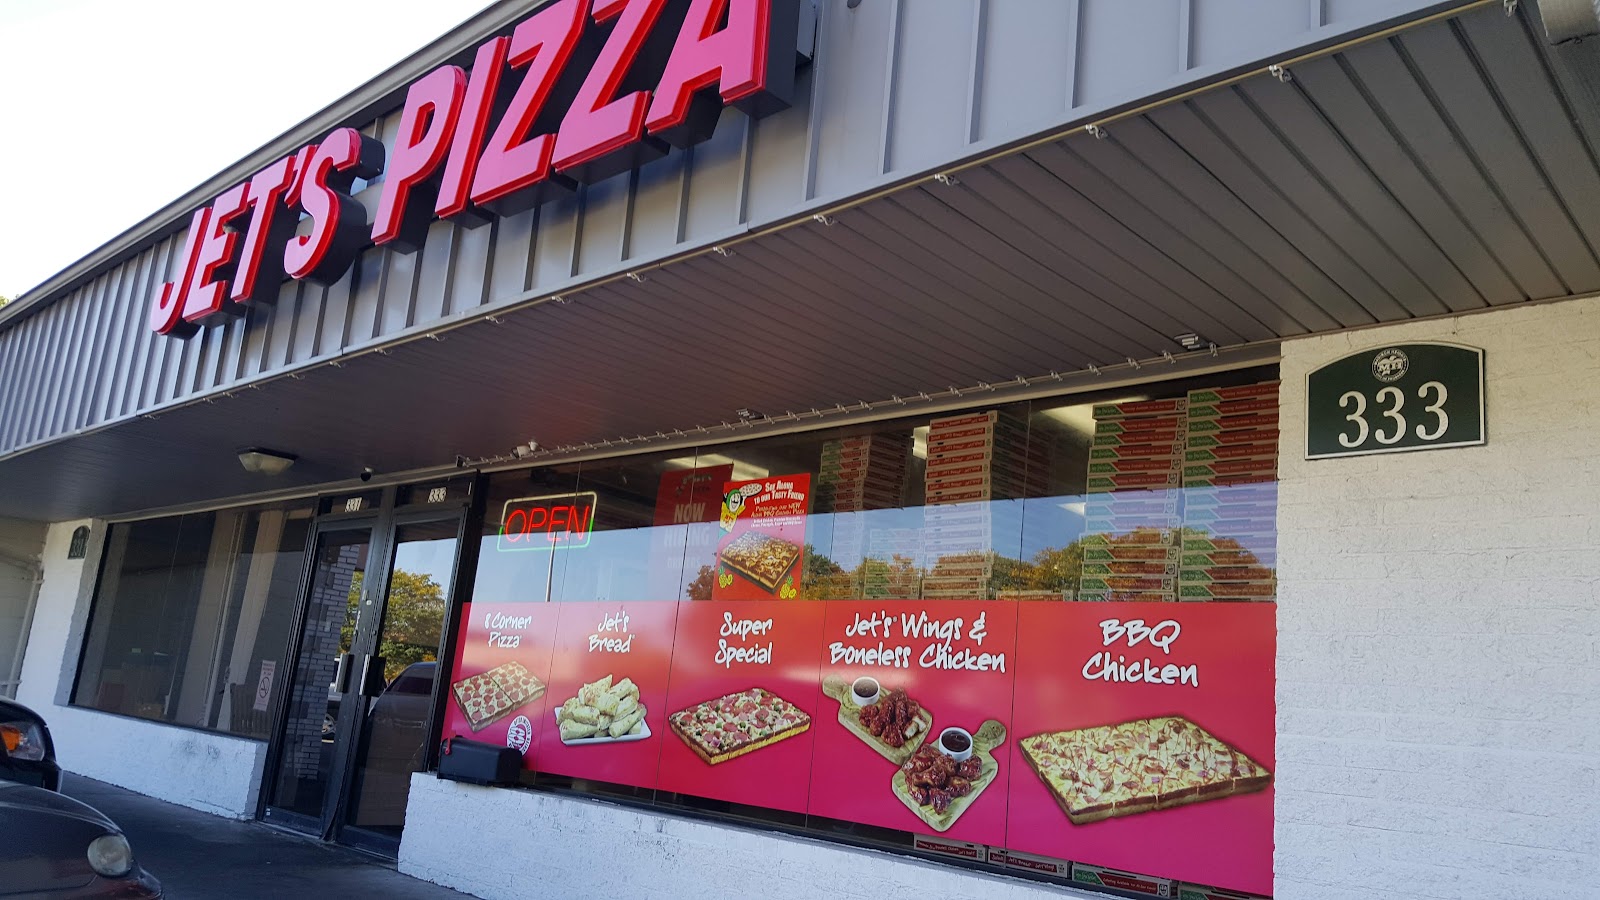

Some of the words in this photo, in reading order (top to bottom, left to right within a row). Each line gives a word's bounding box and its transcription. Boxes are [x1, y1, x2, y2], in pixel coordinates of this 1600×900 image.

[151, 127, 363, 336] JET'S
[371, 0, 773, 246] PIZZA
[1338, 381, 1449, 448] 333
[505, 505, 590, 543] OPEN
[674, 502, 706, 524] NOW
[664, 526, 711, 547] HIRING
[484, 613, 492, 629] 8
[491, 612, 532, 630] Corner
[597, 611, 630, 632] Jet's
[720, 611, 773, 641] Super
[845, 610, 893, 638] Jet's
[901, 610, 964, 650] Wings
[968, 611, 987, 646] &
[1100, 619, 1181, 654] BBQ
[488, 631, 520, 648] Pizza
[588, 634, 632, 653] Bread
[714, 638, 773, 669] Special
[828, 641, 912, 668] Boneless
[919, 642, 1006, 673] Chicken
[1081, 653, 1199, 687] Chicken
